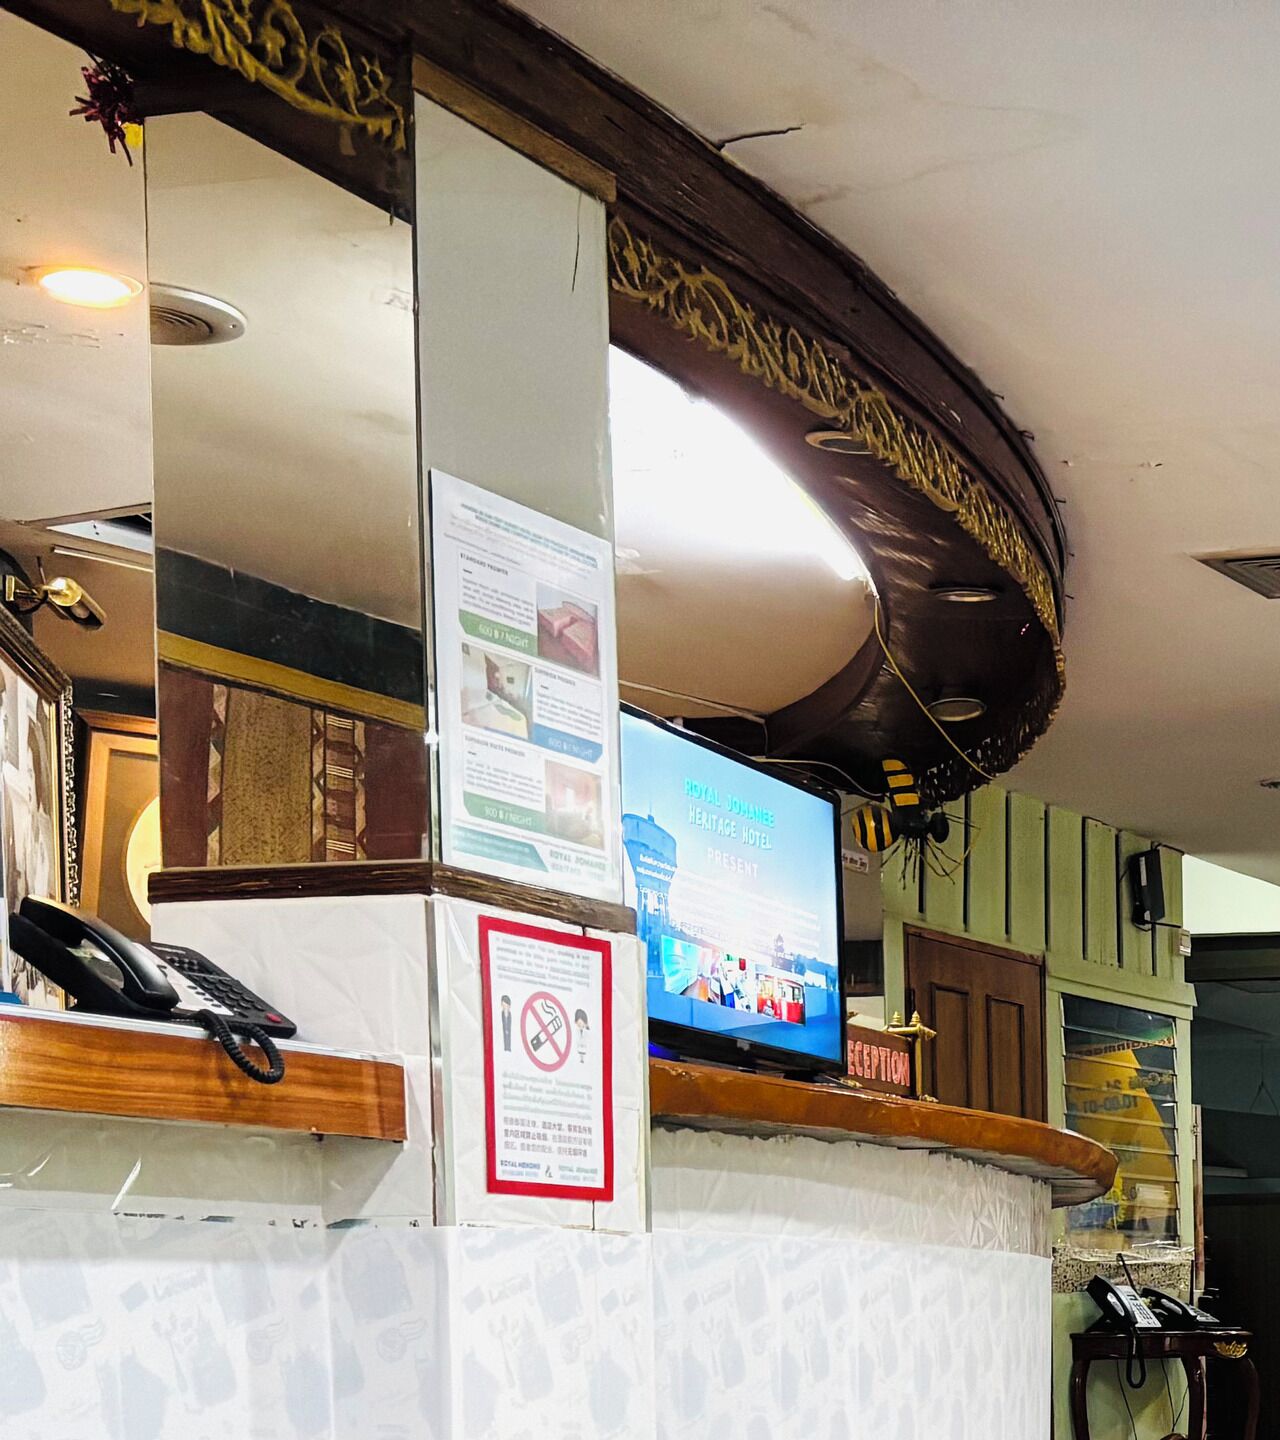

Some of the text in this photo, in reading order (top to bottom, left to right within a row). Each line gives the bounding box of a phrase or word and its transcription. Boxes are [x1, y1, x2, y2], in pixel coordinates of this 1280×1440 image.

[684, 777, 720, 807] ROYAL
[689, 805, 772, 850] HERITAGE HOTEL
[707, 847, 759, 880] PRESENT
[847, 1040, 911, 1087] ECEPTION
